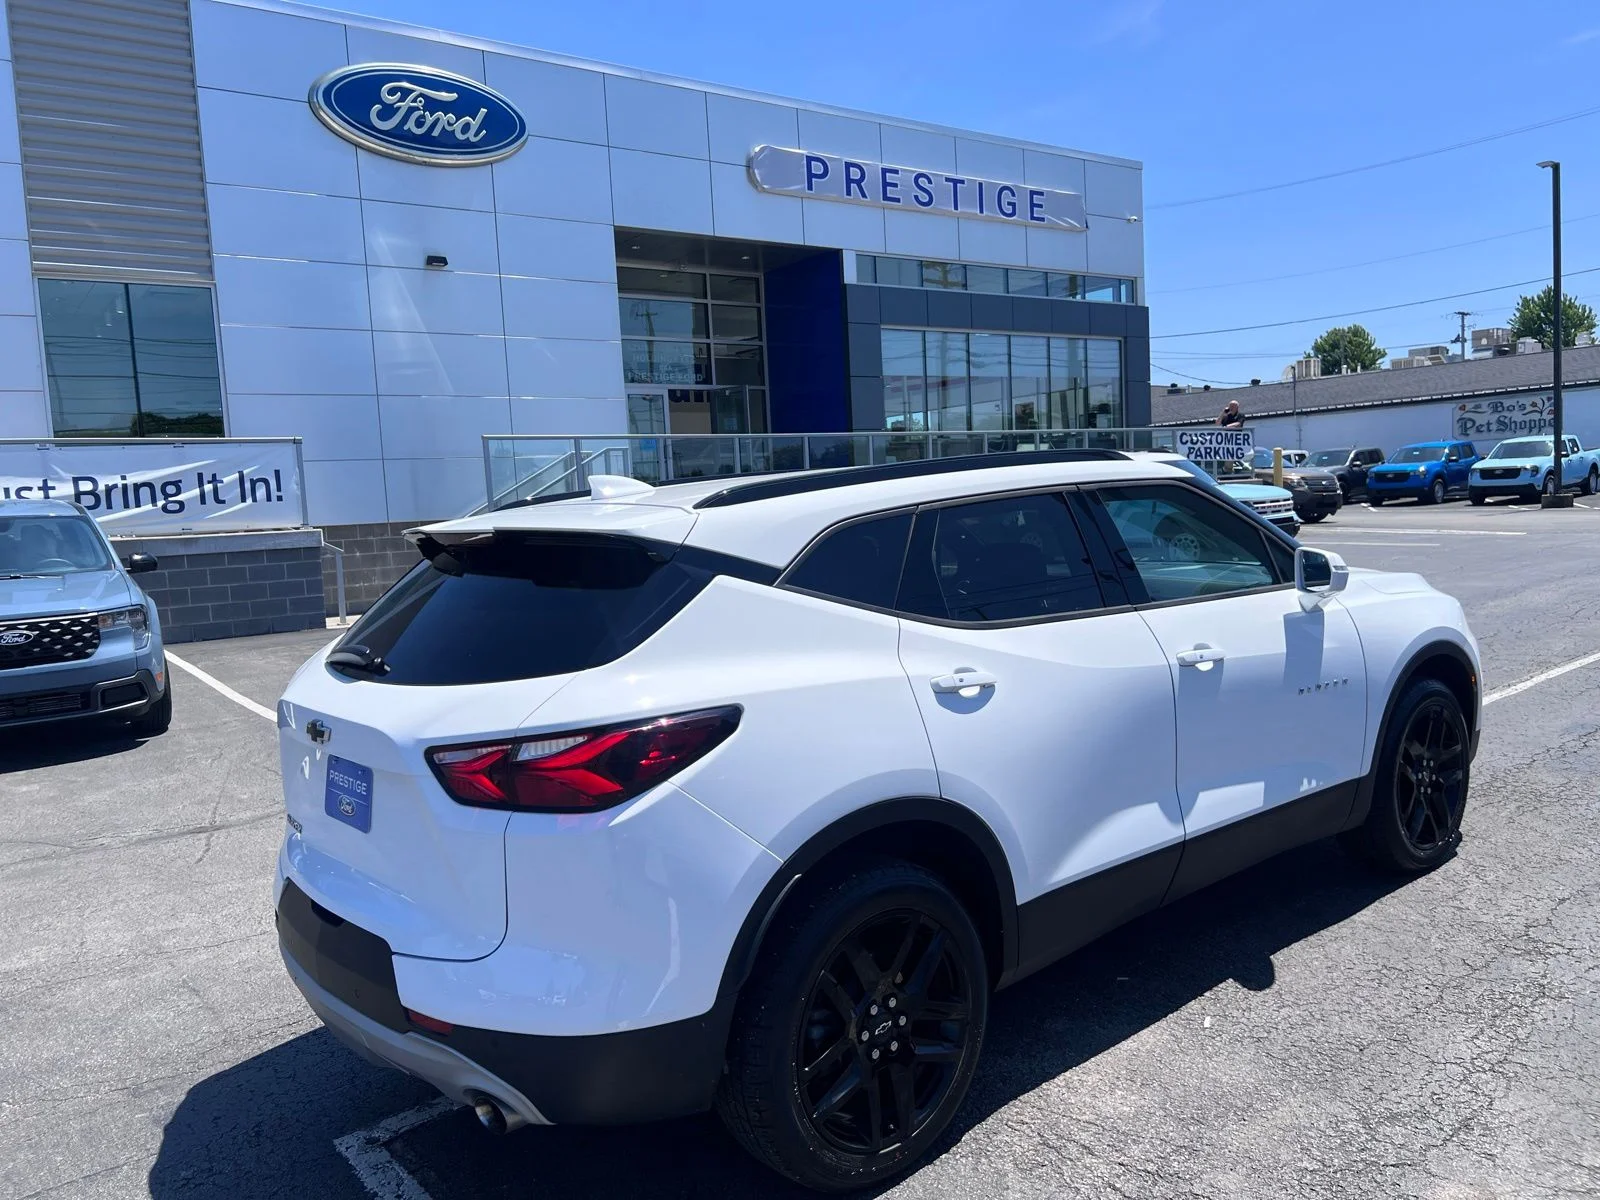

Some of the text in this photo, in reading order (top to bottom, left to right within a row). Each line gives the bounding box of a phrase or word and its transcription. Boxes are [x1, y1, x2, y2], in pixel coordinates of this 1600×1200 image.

[370, 81, 488, 142] Ford
[805, 154, 1046, 223] PRESTIGE
[1488, 400, 1527, 415] Bo's
[1456, 416, 1493, 437] Pet
[1179, 431, 1251, 447] CUSTOMER
[1187, 446, 1245, 460] PARKING
[71, 474, 186, 514] Bring
[197, 471, 227, 506] It
[237, 469, 284, 504] In!
[1, 633, 27, 644] Ford
[329, 769, 368, 796] PRESTIGE
